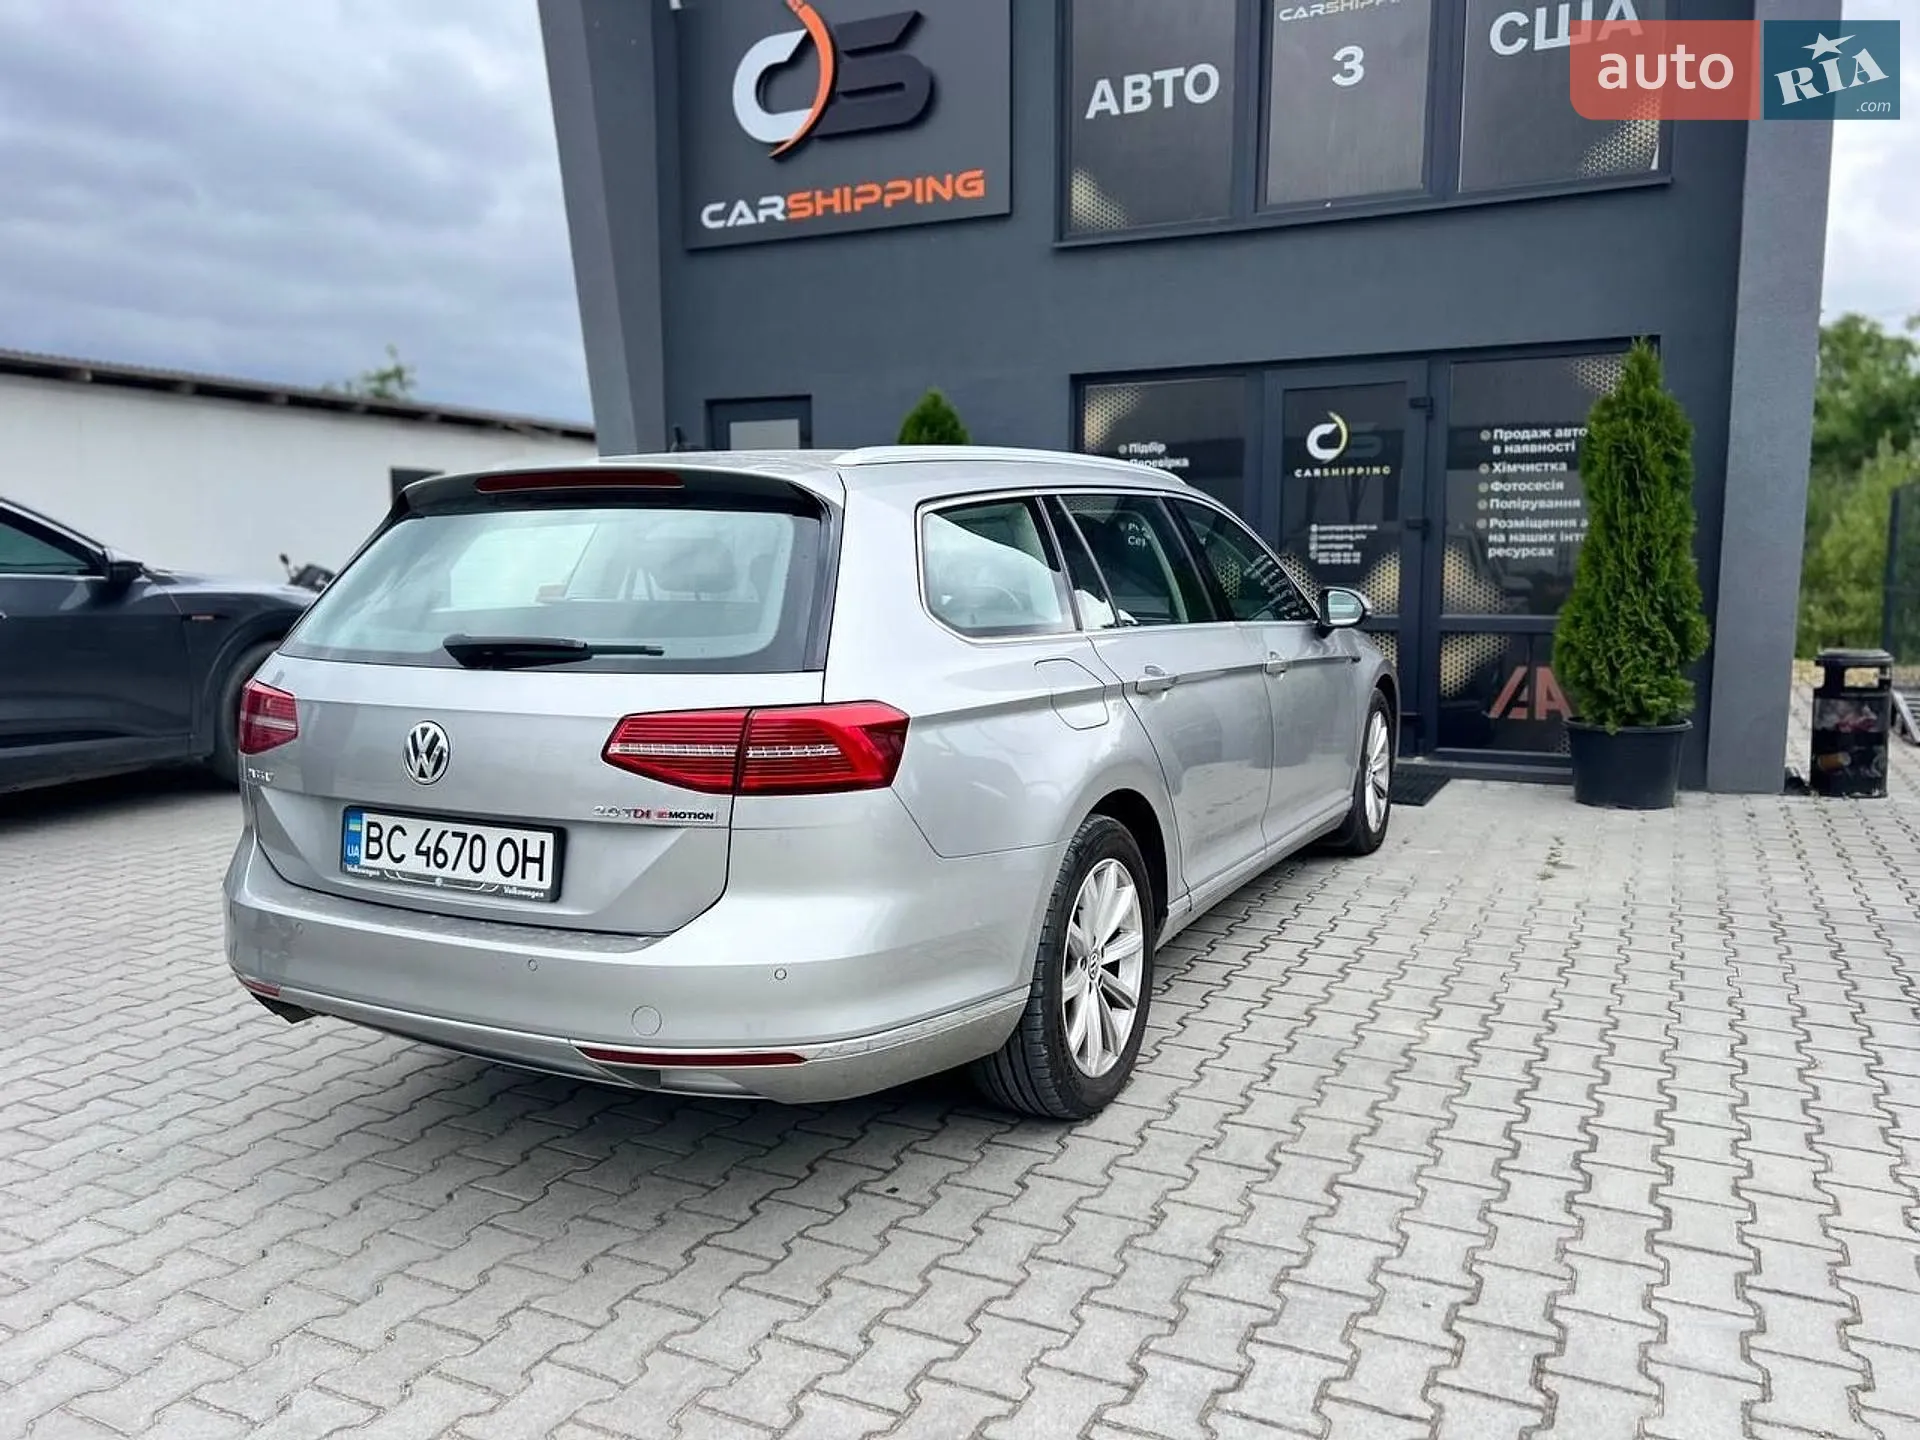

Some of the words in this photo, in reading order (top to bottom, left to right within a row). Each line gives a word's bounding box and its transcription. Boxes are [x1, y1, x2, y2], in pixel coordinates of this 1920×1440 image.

[1085, 62, 1220, 119] АВТО
[1489, 0, 1644, 56] США
[701, 169, 985, 229] CARSHIPPING
[1493, 428, 1551, 442] Продаж
[1555, 427, 1588, 438] авто
[1492, 445, 1501, 455] в
[1504, 440, 1575, 454] наявності
[1294, 465, 1391, 478] CARSHIPPING
[1492, 462, 1568, 474] Хімчистка
[1490, 480, 1565, 492] Фотосесія
[1489, 498, 1581, 511] Полірування
[1489, 517, 1577, 529] Розміщення
[1488, 533, 1506, 543] на
[1509, 533, 1556, 543] наших
[1488, 547, 1555, 560] ресурсах
[622, 808, 651, 819] TDI
[346, 844, 360, 858] UA
[365, 821, 407, 864] BC
[415, 828, 486, 874] 4670
[496, 837, 545, 882] OH
